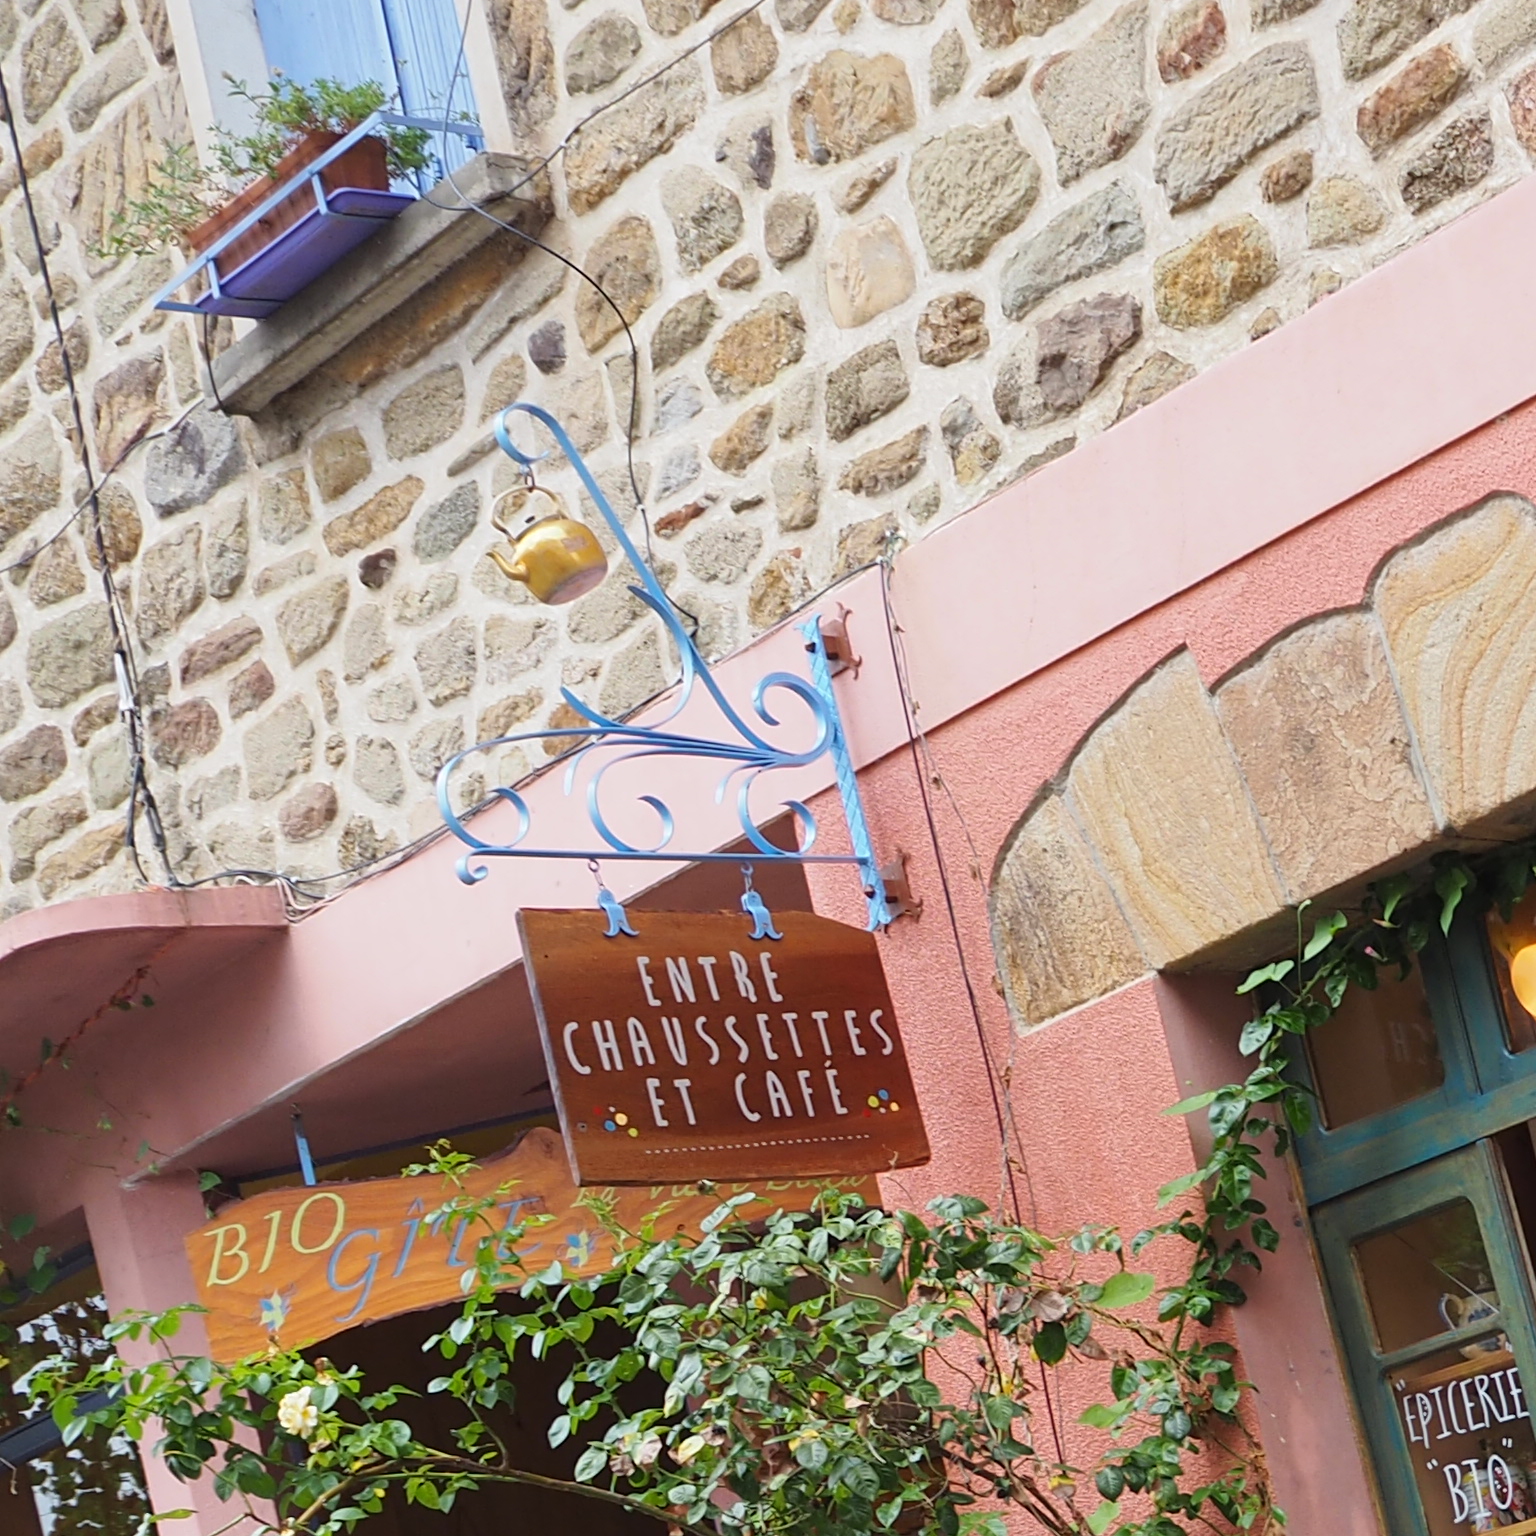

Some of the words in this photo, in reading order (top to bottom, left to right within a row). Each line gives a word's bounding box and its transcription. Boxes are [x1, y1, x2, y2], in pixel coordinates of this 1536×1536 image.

[636, 950, 784, 1007] ENTRE
[563, 1009, 893, 1075] CHAUSSETTES
[646, 1077, 697, 1127] ET
[734, 1060, 848, 1122] CAFÉ
[203, 1192, 345, 1288] BIO
